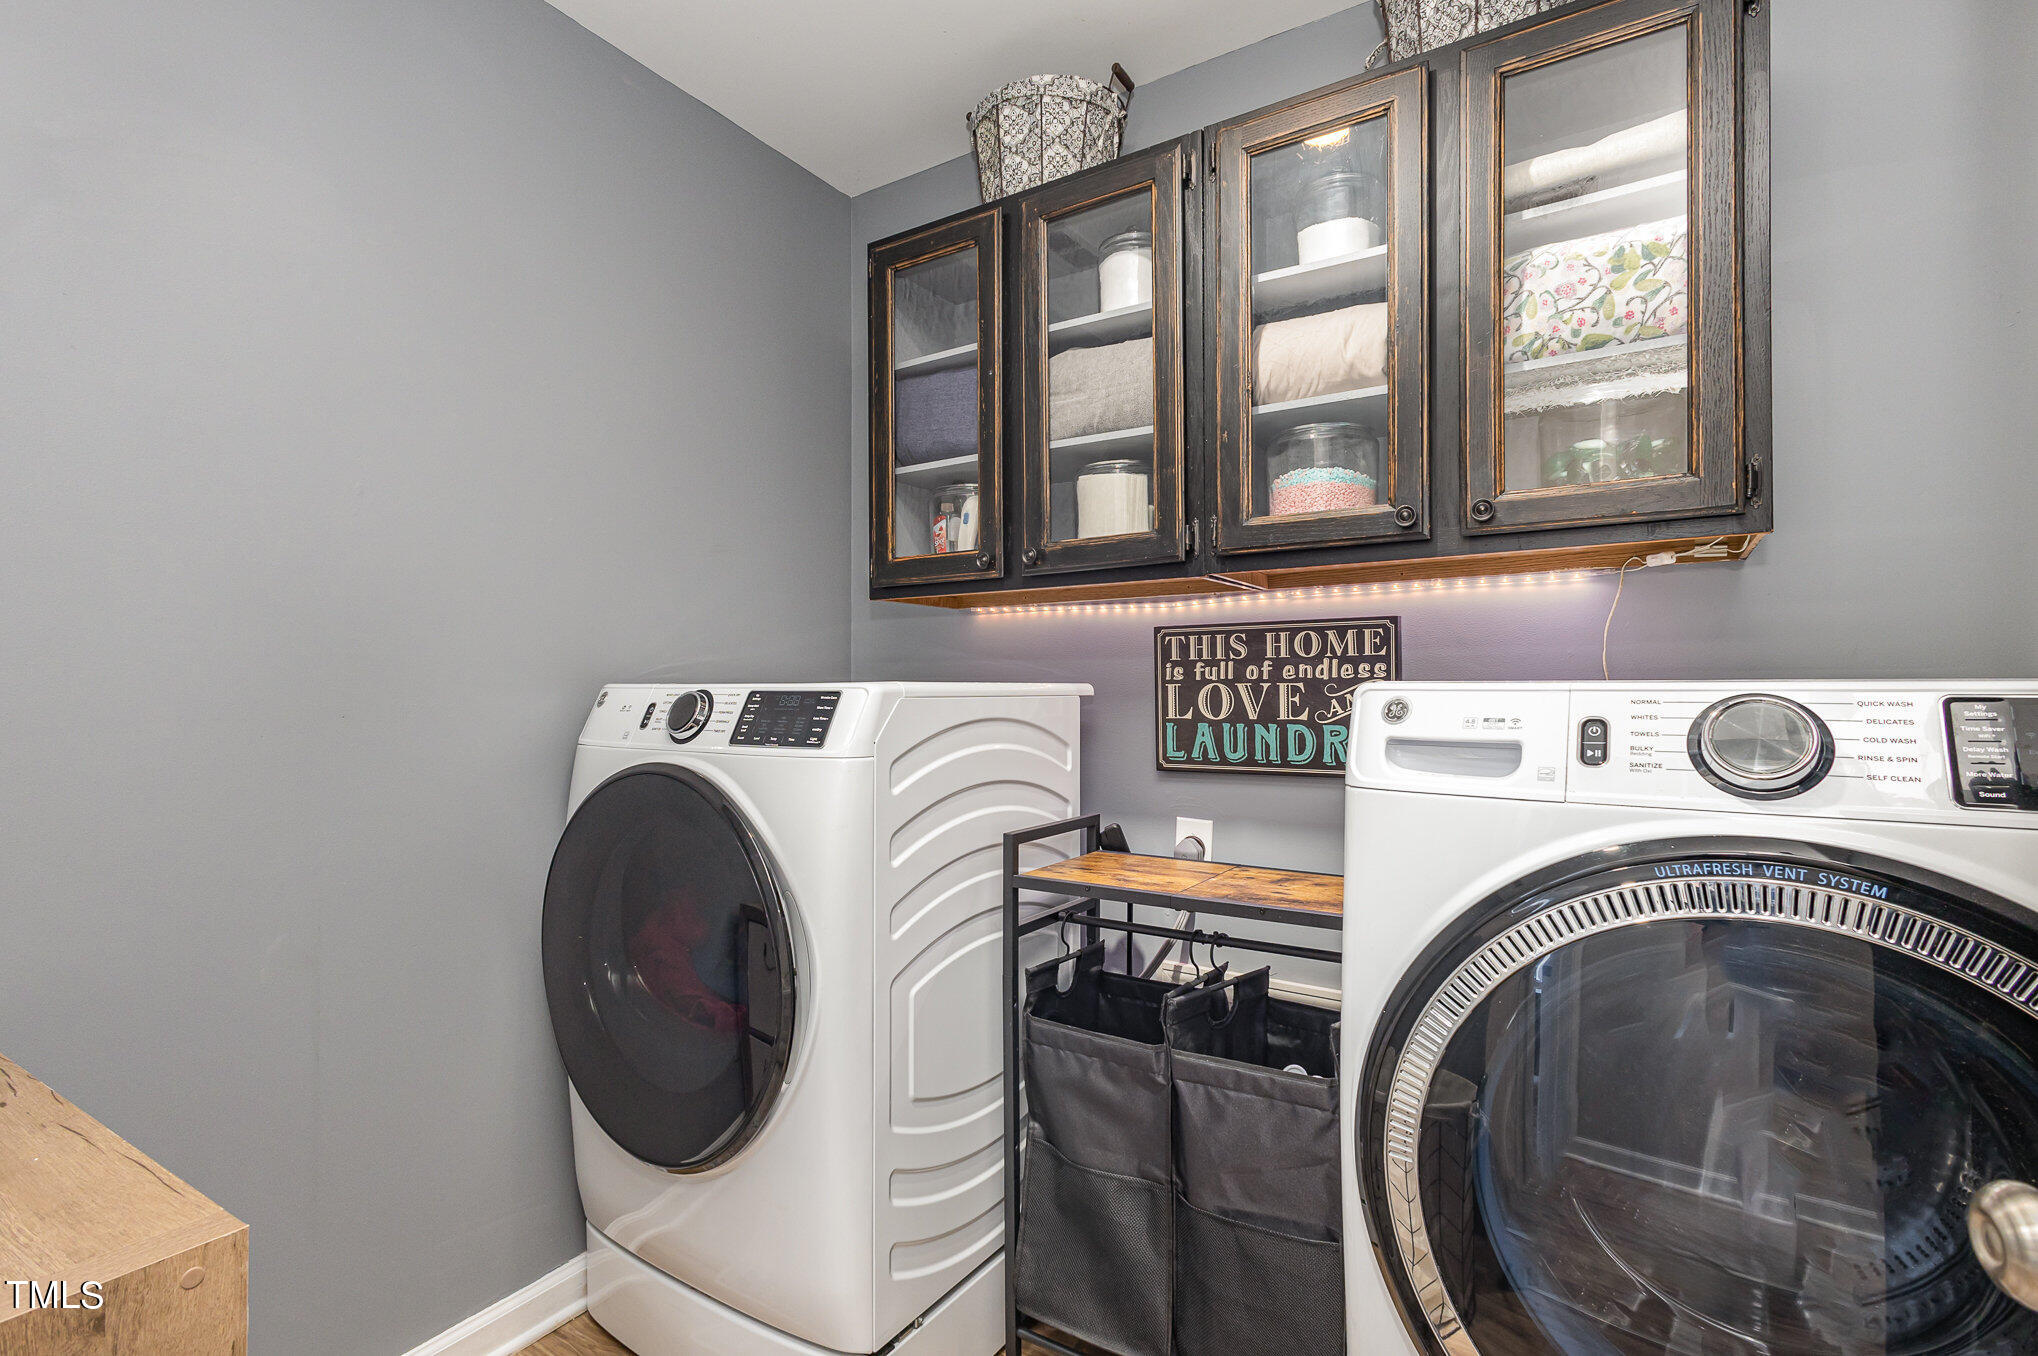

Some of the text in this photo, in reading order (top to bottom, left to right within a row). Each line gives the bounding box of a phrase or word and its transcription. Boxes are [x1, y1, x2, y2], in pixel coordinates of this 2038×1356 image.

[1164, 627, 1387, 661] THIS HOME
[1165, 657, 1387, 681] is full of endless
[1165, 682, 1354, 721] LOVE AN
[1857, 700, 1885, 708] QUICK
[1165, 722, 1348, 766] LAUNDR
[1889, 737, 1917, 745] WASH
[1866, 774, 1922, 783] SELF CLEAN
[1654, 862, 1888, 899] ULTRAFRESH VENT SYSTEM
